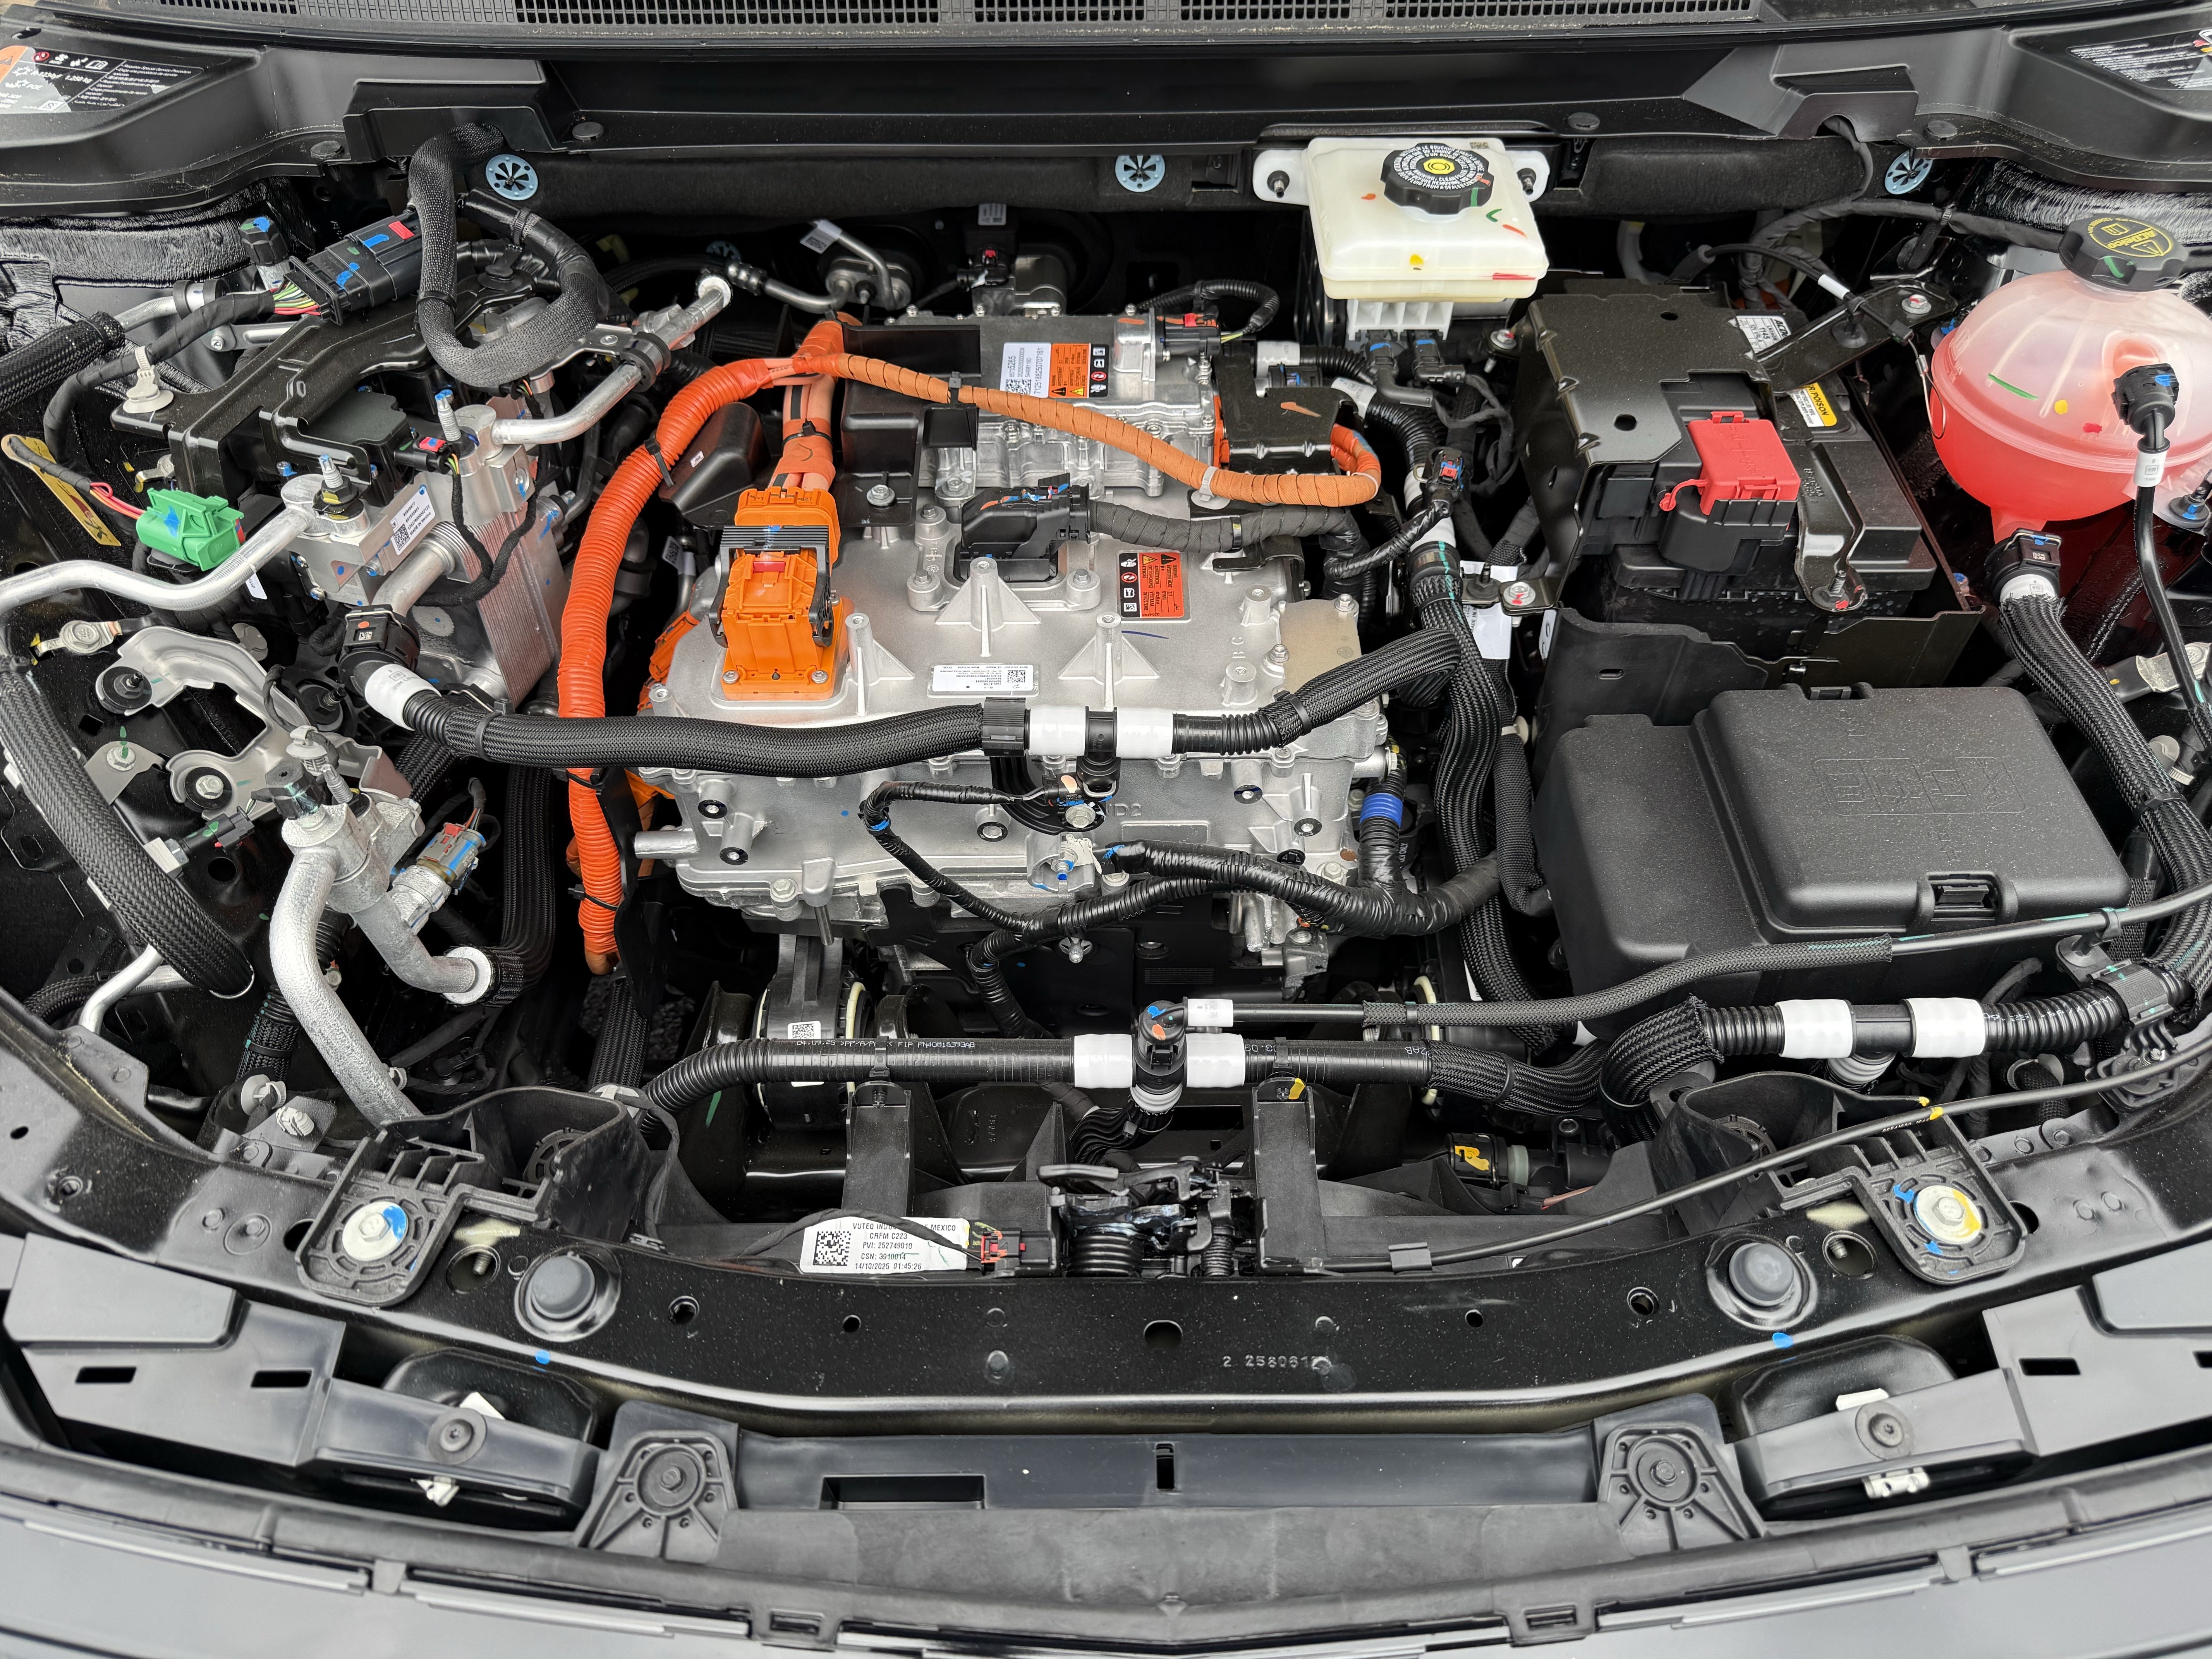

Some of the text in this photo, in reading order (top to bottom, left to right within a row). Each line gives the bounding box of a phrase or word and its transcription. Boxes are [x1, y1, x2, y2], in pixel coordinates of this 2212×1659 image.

[2107, 230, 2156, 249] ACDelco
[1808, 385, 1829, 416] R/POISON
[1398, 843, 1408, 854] ONLY
[1223, 1355, 1232, 1367] 2
